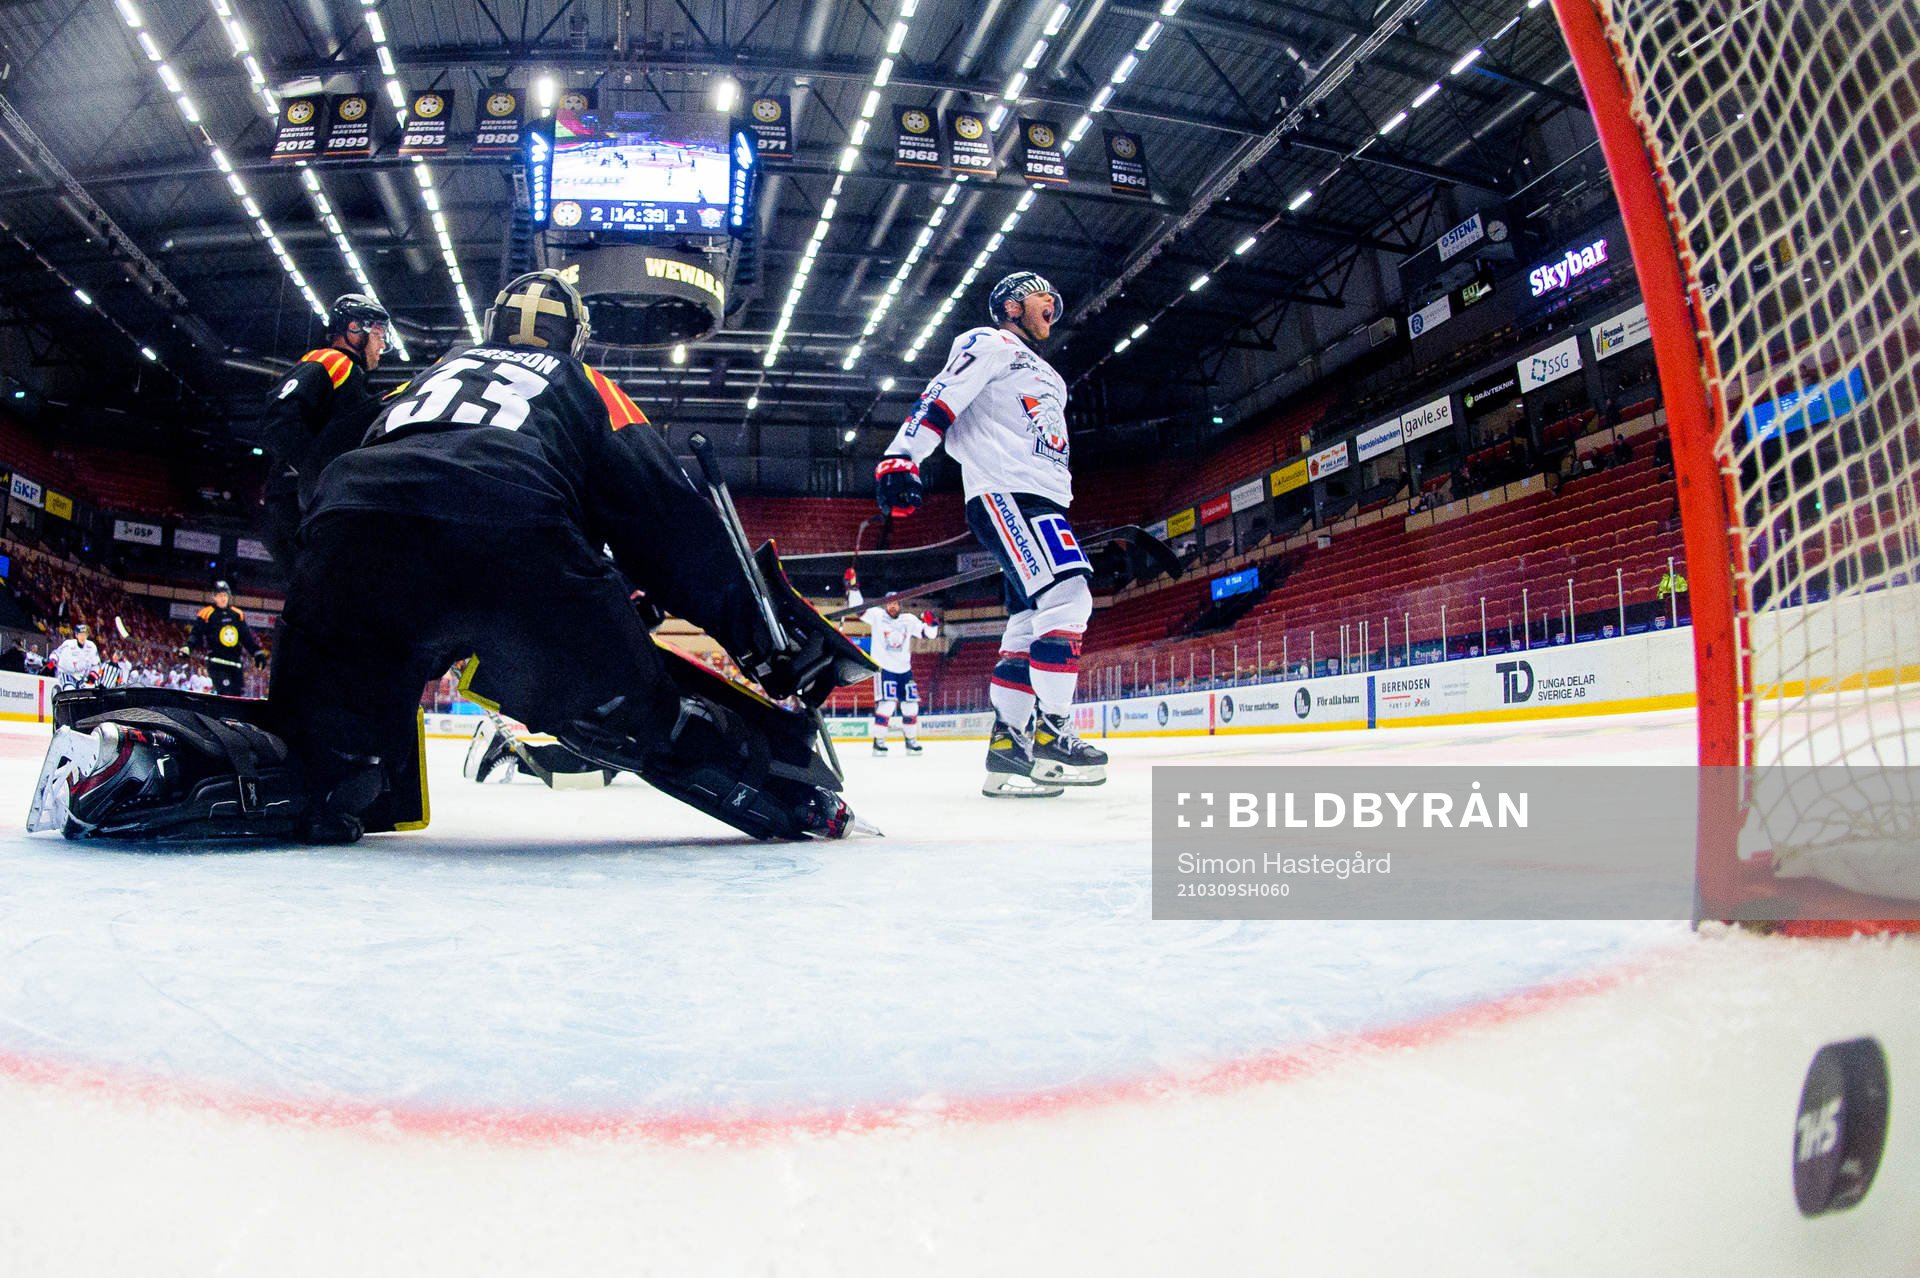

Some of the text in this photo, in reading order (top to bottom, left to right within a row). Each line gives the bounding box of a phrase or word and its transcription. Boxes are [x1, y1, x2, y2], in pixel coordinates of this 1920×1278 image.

[274, 139, 316, 152] 2012
[328, 136, 369, 148] 1999
[403, 134, 446, 145] 1993
[477, 133, 519, 144] 1980
[757, 139, 787, 150] 971
[898, 149, 938, 162] 1968
[952, 154, 992, 167] 1967
[1026, 162, 1064, 176] 1966
[1111, 173, 1146, 186] 1964
[590, 207, 688, 224] 2 14:39 1
[1449, 217, 1478, 248] STENA
[1529, 238, 1608, 297] Skybar
[1548, 351, 1569, 376] SSG
[385, 357, 550, 433] 53
[1405, 404, 1449, 438] gavle.se
[1358, 428, 1401, 453] Handelsbanken
[13, 480, 39, 500] SKF
[134, 527, 153, 538] GSP
[1382, 677, 1430, 693] BERENDSEN
[1537, 674, 1596, 690] TUNGA DELAR
[1317, 694, 1360, 707] För alla barn
[1538, 687, 1586, 702] SVERIGE AB
[1239, 702, 1280, 713] Vi tar matchen
